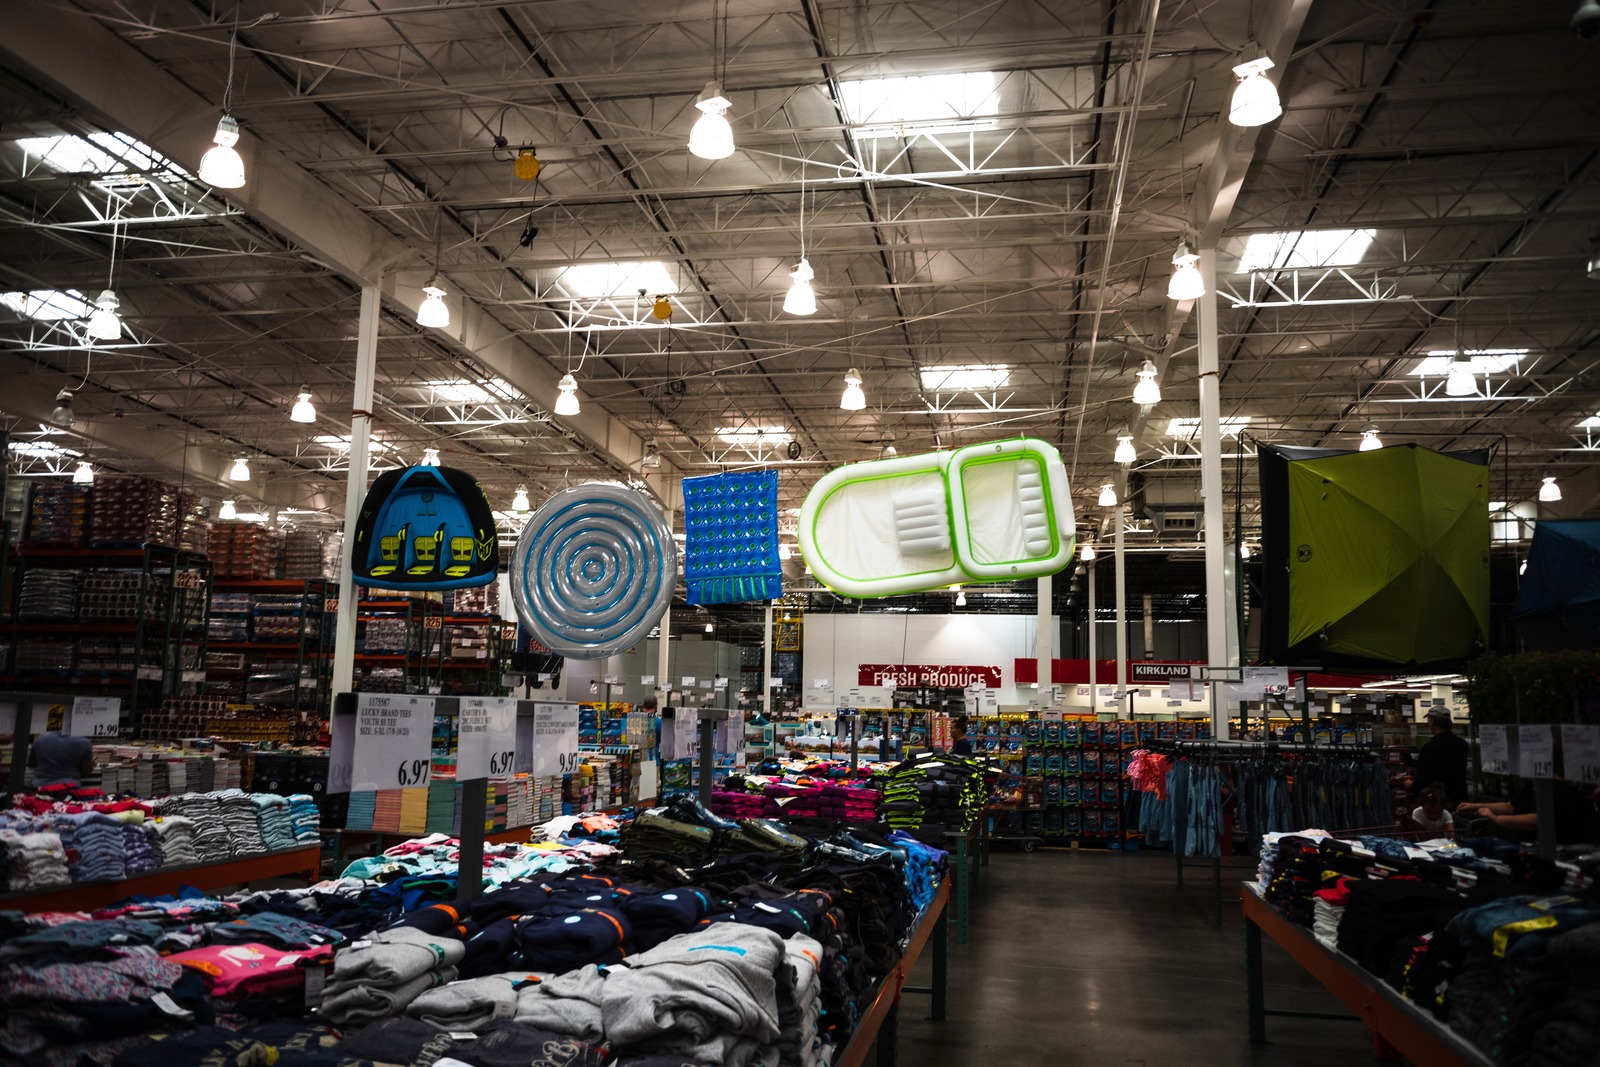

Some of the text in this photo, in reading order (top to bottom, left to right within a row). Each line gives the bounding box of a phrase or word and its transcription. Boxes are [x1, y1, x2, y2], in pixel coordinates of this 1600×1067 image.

[1136, 666, 1188, 675] KIRKLAND
[874, 672, 986, 687] FRESH PRODUCE
[361, 708, 412, 718] LUCKY BRAND TEES
[360, 718, 379, 726] YOUTH
[387, 718, 397, 727] TEE
[94, 724, 118, 736] 12.99
[490, 751, 514, 774] 6.97
[560, 752, 578, 773] 9.97
[398, 760, 429, 786] 6.97
